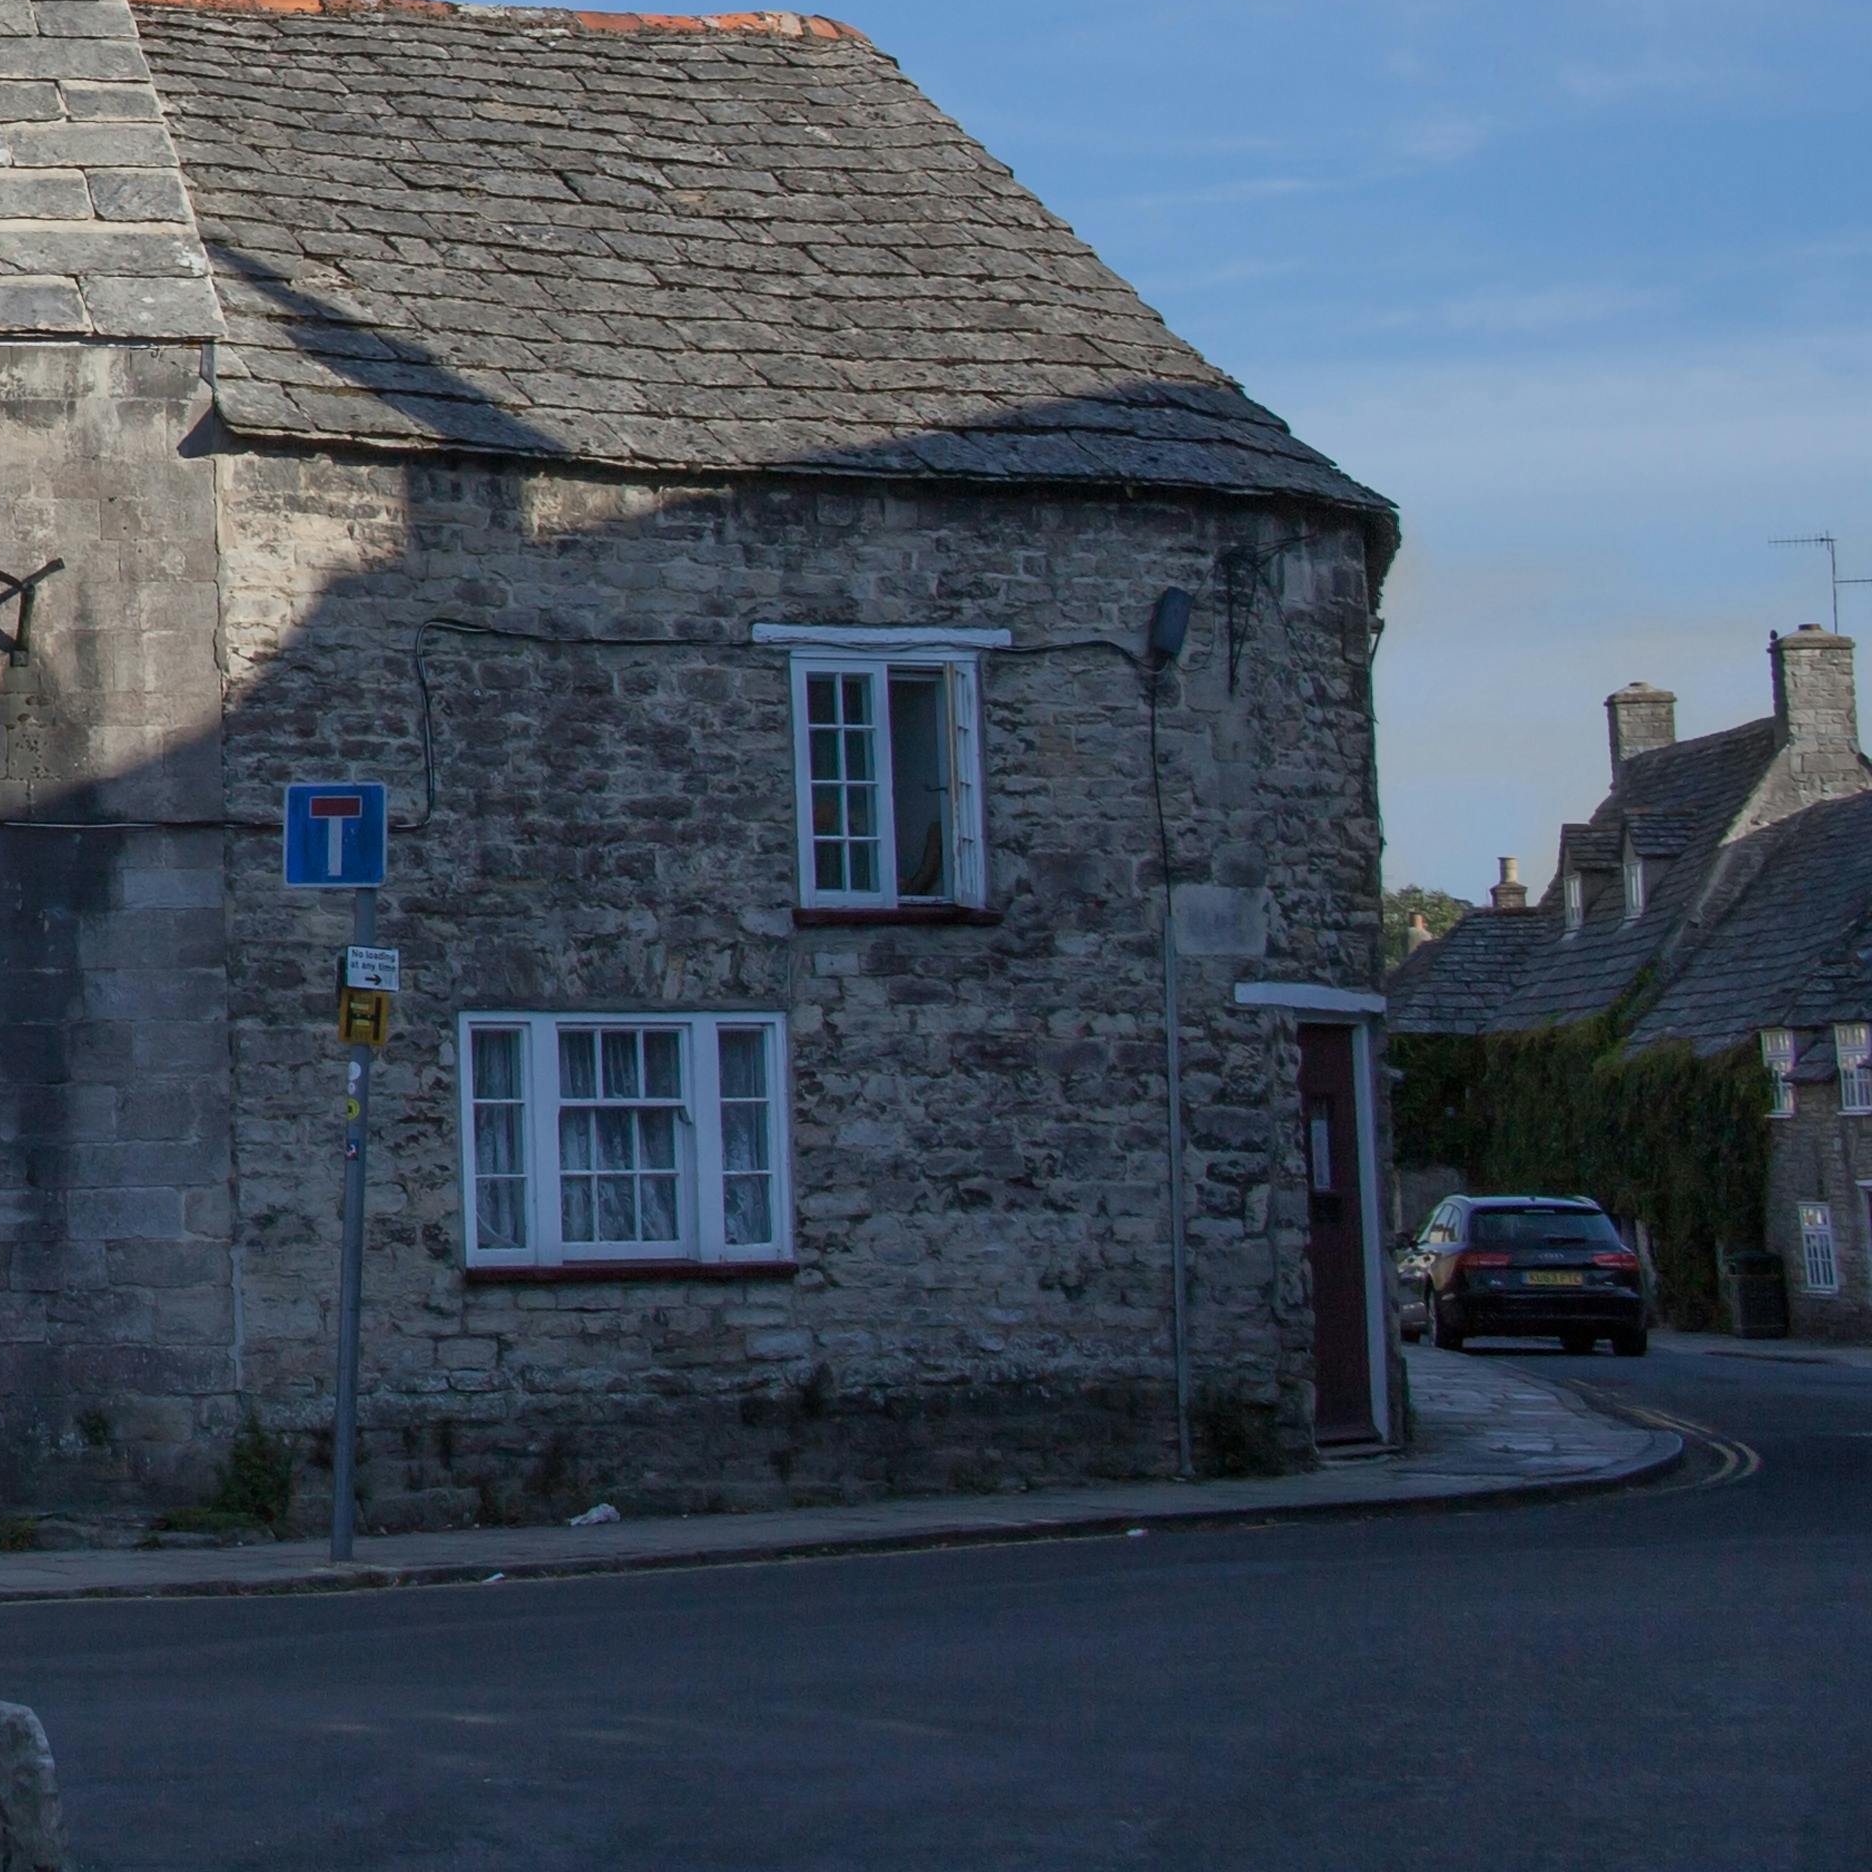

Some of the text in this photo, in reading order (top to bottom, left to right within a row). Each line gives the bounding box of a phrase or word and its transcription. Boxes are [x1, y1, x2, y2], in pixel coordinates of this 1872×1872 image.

[351, 948, 396, 963] No loading
[350, 961, 397, 972] at any time
[344, 993, 383, 1041] H
